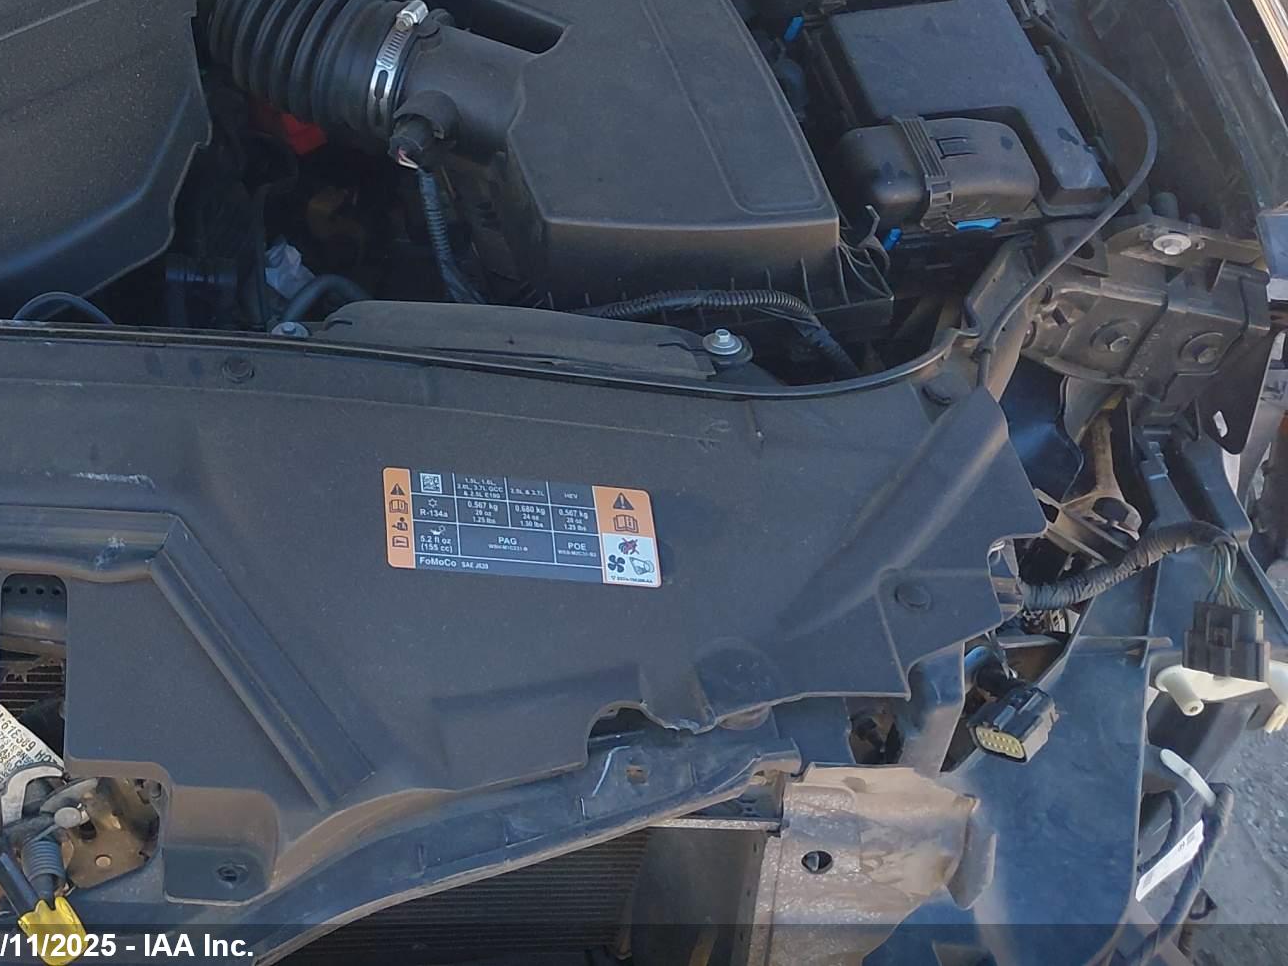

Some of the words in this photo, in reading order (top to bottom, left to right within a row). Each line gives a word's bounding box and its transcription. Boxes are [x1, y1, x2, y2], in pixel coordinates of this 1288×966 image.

[467, 500, 487, 509] 0.567
[488, 502, 499, 512] kg
[514, 504, 535, 513] 0.680
[536, 506, 546, 515] kg
[419, 508, 448, 518] R-134a
[578, 510, 589, 520] kg
[420, 535, 432, 543] 5.2
[497, 536, 518, 545] PAG
[421, 543, 439, 552] (155
[440, 545, 453, 553] cc)
[567, 542, 587, 550] POE
[419, 556, 457, 567] FoMoCo
